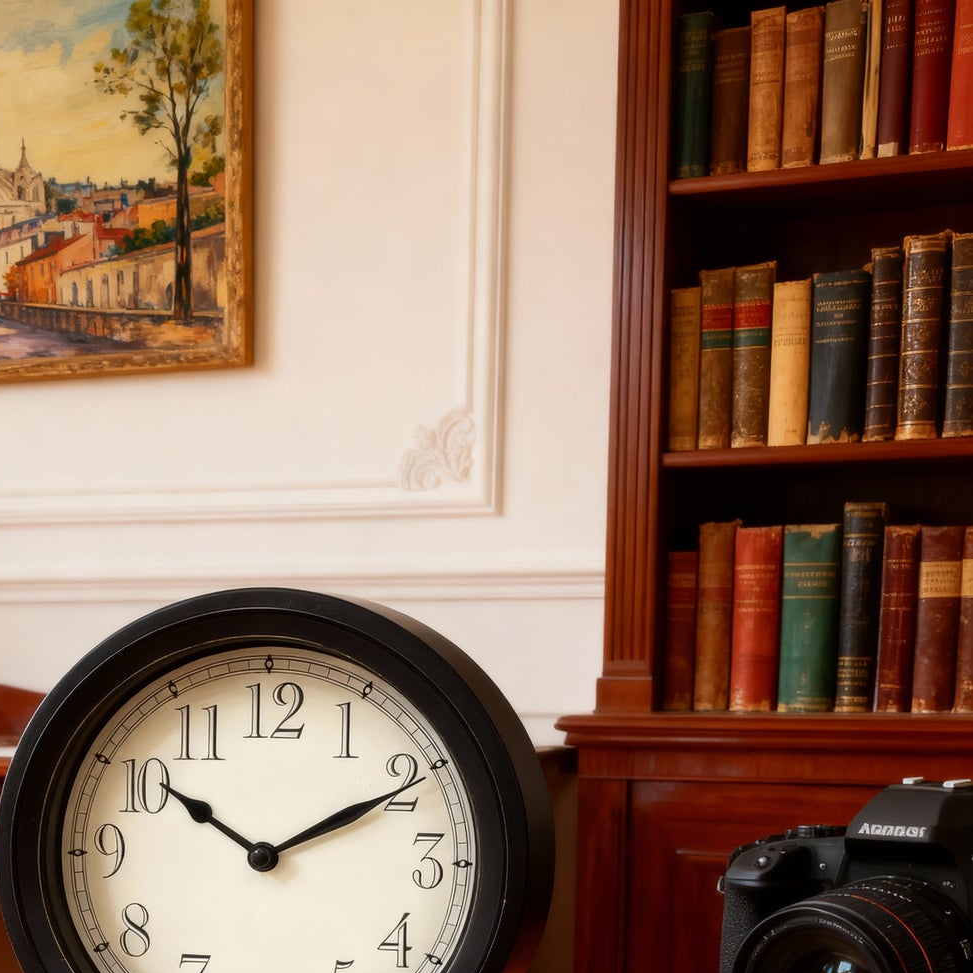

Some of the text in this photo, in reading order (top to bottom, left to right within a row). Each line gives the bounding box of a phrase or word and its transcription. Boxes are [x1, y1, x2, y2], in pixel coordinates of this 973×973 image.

[173, 704, 226, 760] 11
[243, 682, 305, 740] 12
[332, 702, 359, 758] 1
[119, 757, 170, 814] 10
[383, 753, 419, 812] 2
[93, 823, 126, 878] 9
[412, 832, 445, 889] 3
[119, 902, 150, 957] 8
[377, 912, 413, 968] 4
